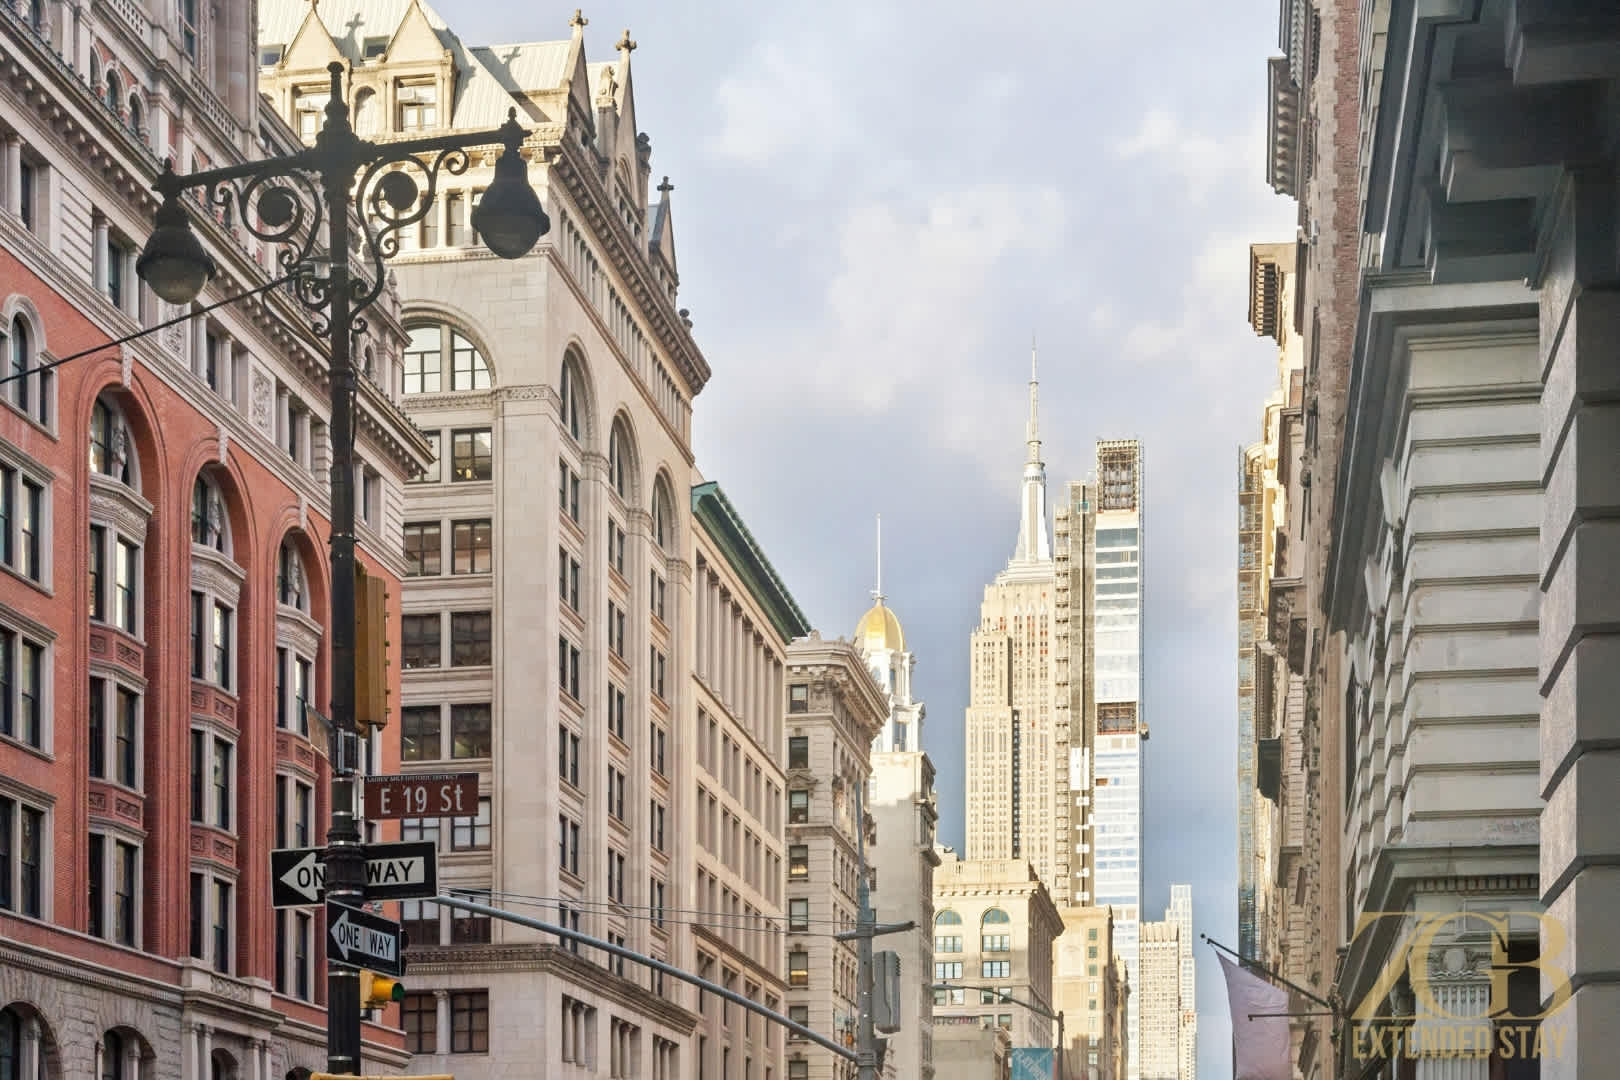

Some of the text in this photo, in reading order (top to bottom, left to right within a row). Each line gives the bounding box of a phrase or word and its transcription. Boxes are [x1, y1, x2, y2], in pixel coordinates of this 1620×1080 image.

[381, 784, 463, 814] E 19 St
[297, 860, 415, 888] ON WAY
[338, 922, 391, 957] ONE WAY
